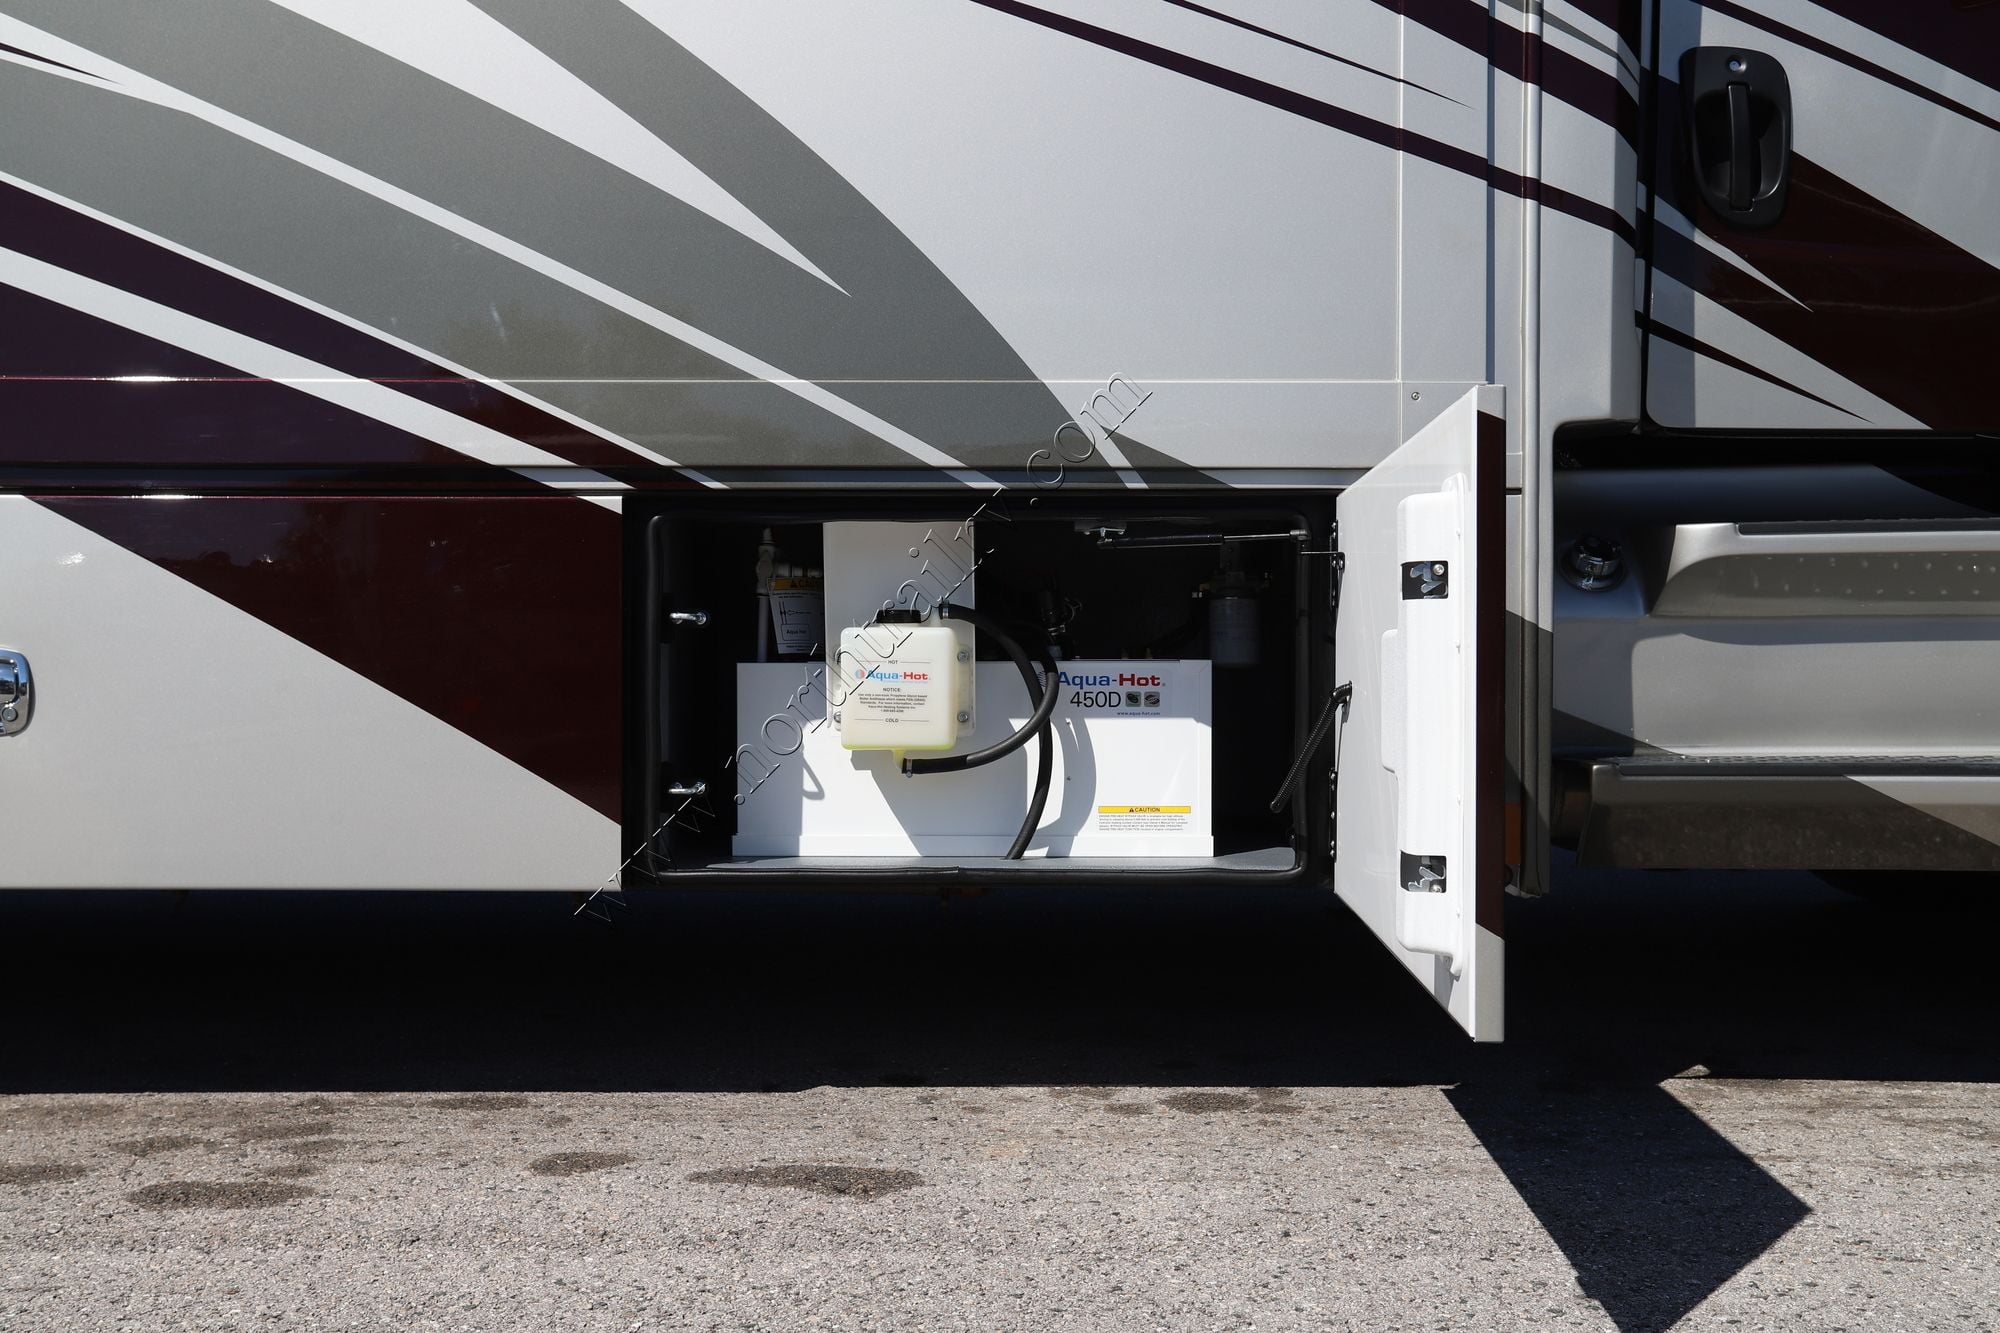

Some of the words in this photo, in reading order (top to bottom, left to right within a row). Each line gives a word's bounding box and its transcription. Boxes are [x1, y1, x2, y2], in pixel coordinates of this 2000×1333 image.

[867, 670, 929, 682] Aqua-Hot
[1059, 671, 1161, 690] Aqua-Hot
[1070, 691, 1121, 708] 450D
